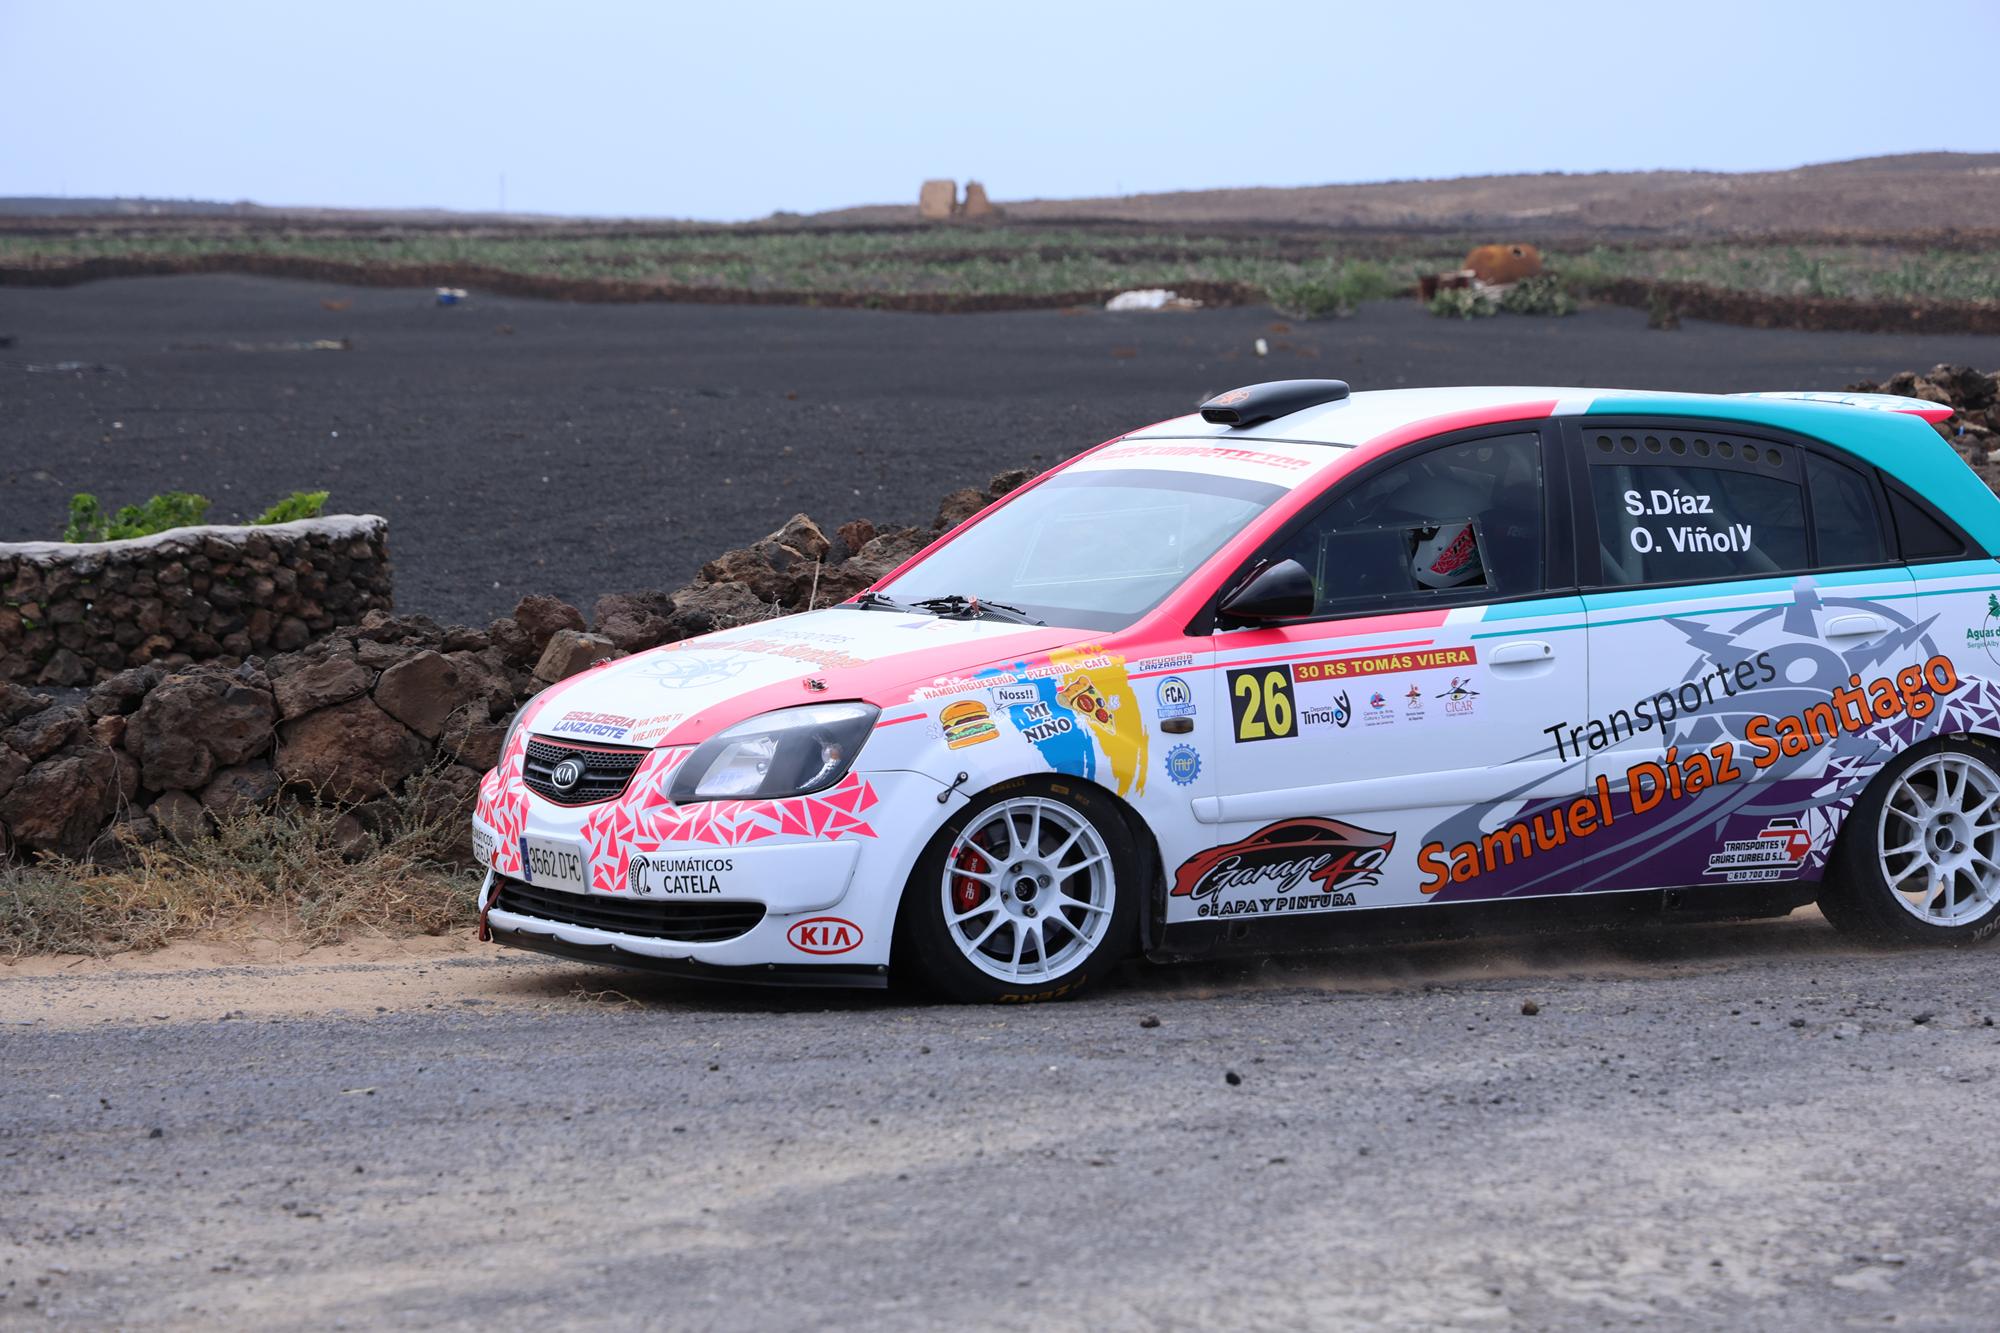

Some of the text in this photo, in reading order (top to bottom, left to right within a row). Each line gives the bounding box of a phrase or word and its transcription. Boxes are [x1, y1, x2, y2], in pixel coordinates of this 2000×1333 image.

[1624, 489, 1713, 517] S.Díaz
[1630, 522, 1752, 554] O. Viñoly
[1967, 628, 1994, 641] Aguas
[1140, 659, 1193, 671] LANZAROTE
[1299, 650, 1470, 679] 30 RS TOMÁS VIERA
[923, 674, 1016, 699] HAMBURGUESERÍA
[1027, 664, 1073, 680] PIZZERÍA
[1084, 656, 1111, 669] CAFÉ
[1165, 686, 1184, 703] FCA
[1025, 702, 1050, 721] MI
[1234, 670, 1293, 740] 26
[1445, 700, 1473, 713] CICAR
[1543, 651, 1777, 763] Transportes
[1301, 709, 1344, 726] Tinajo
[552, 721, 629, 739] LANZAROTE
[1023, 718, 1071, 743] NIÑO
[555, 769, 572, 783] KIA
[1417, 654, 1959, 895] Samuel Díaz Santiago
[1726, 840, 1787, 852] TRANSPORTES Y
[529, 847, 581, 881] 3562 DTC
[652, 856, 733, 872] NEUMÁTICOS
[1737, 852, 1771, 863] CURBELO
[663, 875, 721, 894] CATELA
[1190, 853, 1332, 901] Garage
[1733, 871, 1747, 879] 610
[1749, 871, 1762, 879] 700
[1197, 892, 1357, 917] CHAPA Y PINTURA
[800, 927, 851, 945] KIA
